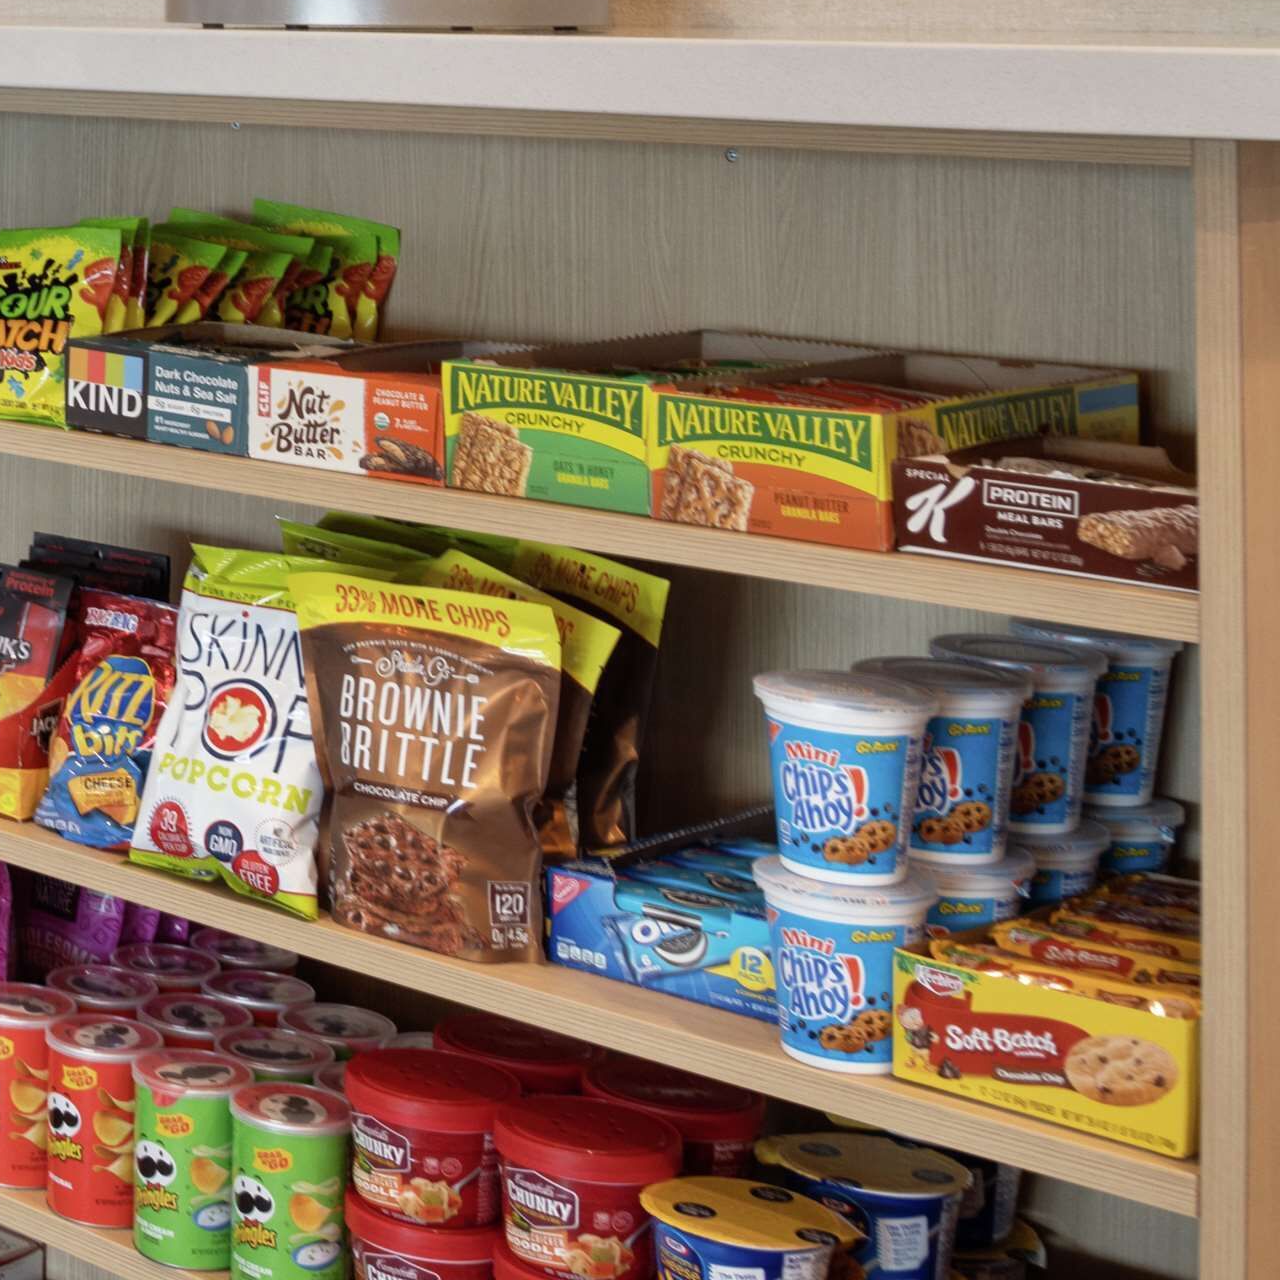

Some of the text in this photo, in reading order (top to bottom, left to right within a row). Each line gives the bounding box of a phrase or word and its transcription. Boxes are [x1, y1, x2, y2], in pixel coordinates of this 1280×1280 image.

[0, 347, 37, 371] Kids
[155, 366, 239, 391] Dark Chocolate
[68, 380, 143, 420] KIND
[154, 380, 238, 406] Nuts & Sea Salt
[258, 381, 271, 413] CLIF
[278, 386, 330, 421] Nut
[372, 397, 429, 411] PEANUT BUTTER
[375, 388, 418, 401] CHOCOLATE
[457, 370, 639, 430] NATURE VALLEY
[504, 411, 585, 435] CRUNCHY
[664, 399, 867, 462] NATURE VALLEY
[941, 391, 1074, 451] NATURE VALLEY
[271, 420, 341, 453] Butter
[294, 447, 328, 461] BAR
[553, 459, 574, 474] OATS
[716, 442, 807, 469] CRUNCHY
[556, 472, 610, 490] GRANOLA BARS
[904, 468, 951, 483] SPECIAL
[773, 491, 850, 514] PEANUT BUTTER
[904, 476, 976, 543] K
[990, 486, 1072, 511] PROTEIN
[780, 505, 841, 525] GRANOLA BARS
[996, 511, 1064, 529] MEAL BARS
[5, 576, 55, 597] Protein
[335, 583, 511, 639] 33% MORE CHIPS
[66, 661, 155, 727] RITZ
[341, 674, 488, 742] BROWNIE
[73, 724, 143, 758] bits
[340, 720, 486, 789] BRITTLE
[785, 741, 841, 768] Mini
[84, 774, 133, 790] CHEESE
[159, 751, 313, 817] POPCORN
[782, 763, 849, 804] Chips
[354, 782, 449, 811] CHOCOLATE CHIP
[160, 808, 178, 833] 39
[209, 834, 238, 856] GMO
[240, 869, 274, 895] FREE
[495, 893, 524, 916] 120
[782, 928, 836, 955] Mini
[740, 951, 763, 973] 12
[779, 950, 846, 988] Chips
[992, 1027, 1058, 1056] Batch
[995, 1066, 1066, 1085] Chocolate Chip
[352, 1124, 405, 1166] CHUNKY
[506, 1180, 573, 1222] CHUNKY
